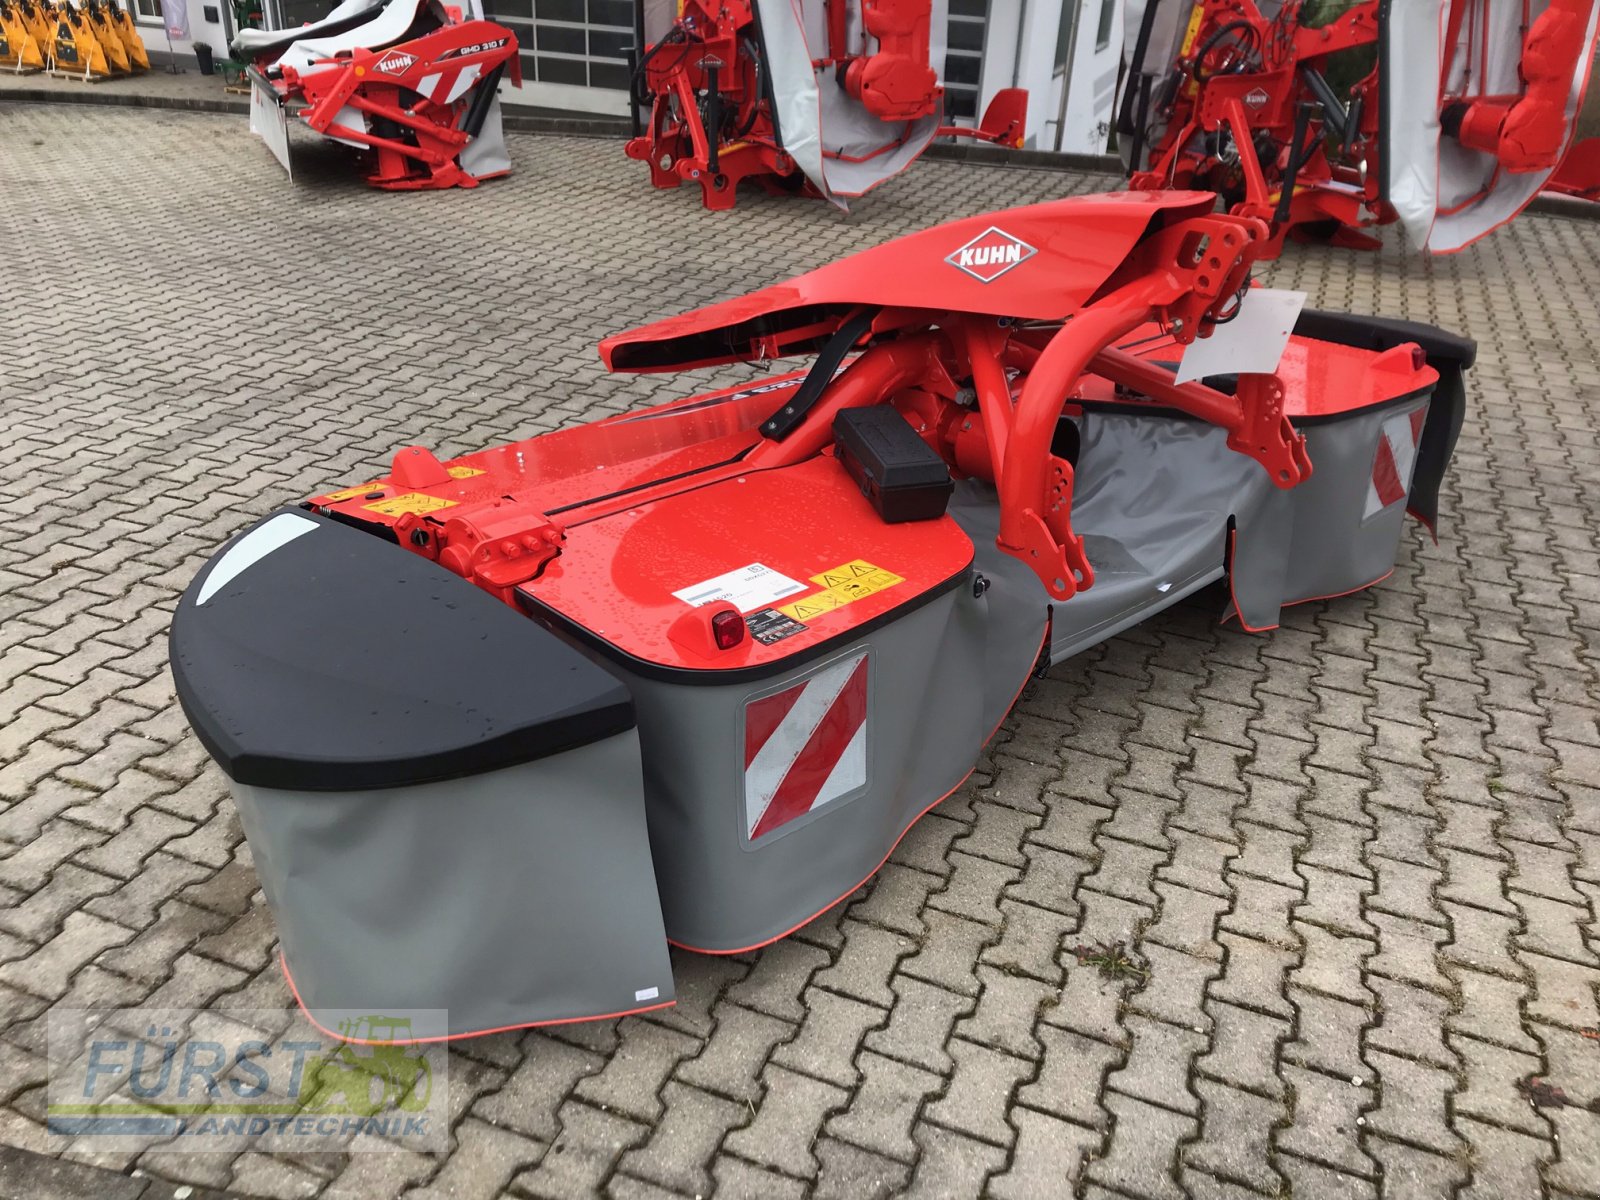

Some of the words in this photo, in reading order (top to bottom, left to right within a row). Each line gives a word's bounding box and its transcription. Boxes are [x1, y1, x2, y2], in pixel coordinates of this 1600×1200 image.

[460, 45, 480, 55] GMD
[482, 41, 498, 50] 310
[379, 56, 412, 72] KUHN
[960, 244, 1021, 266] KUHN
